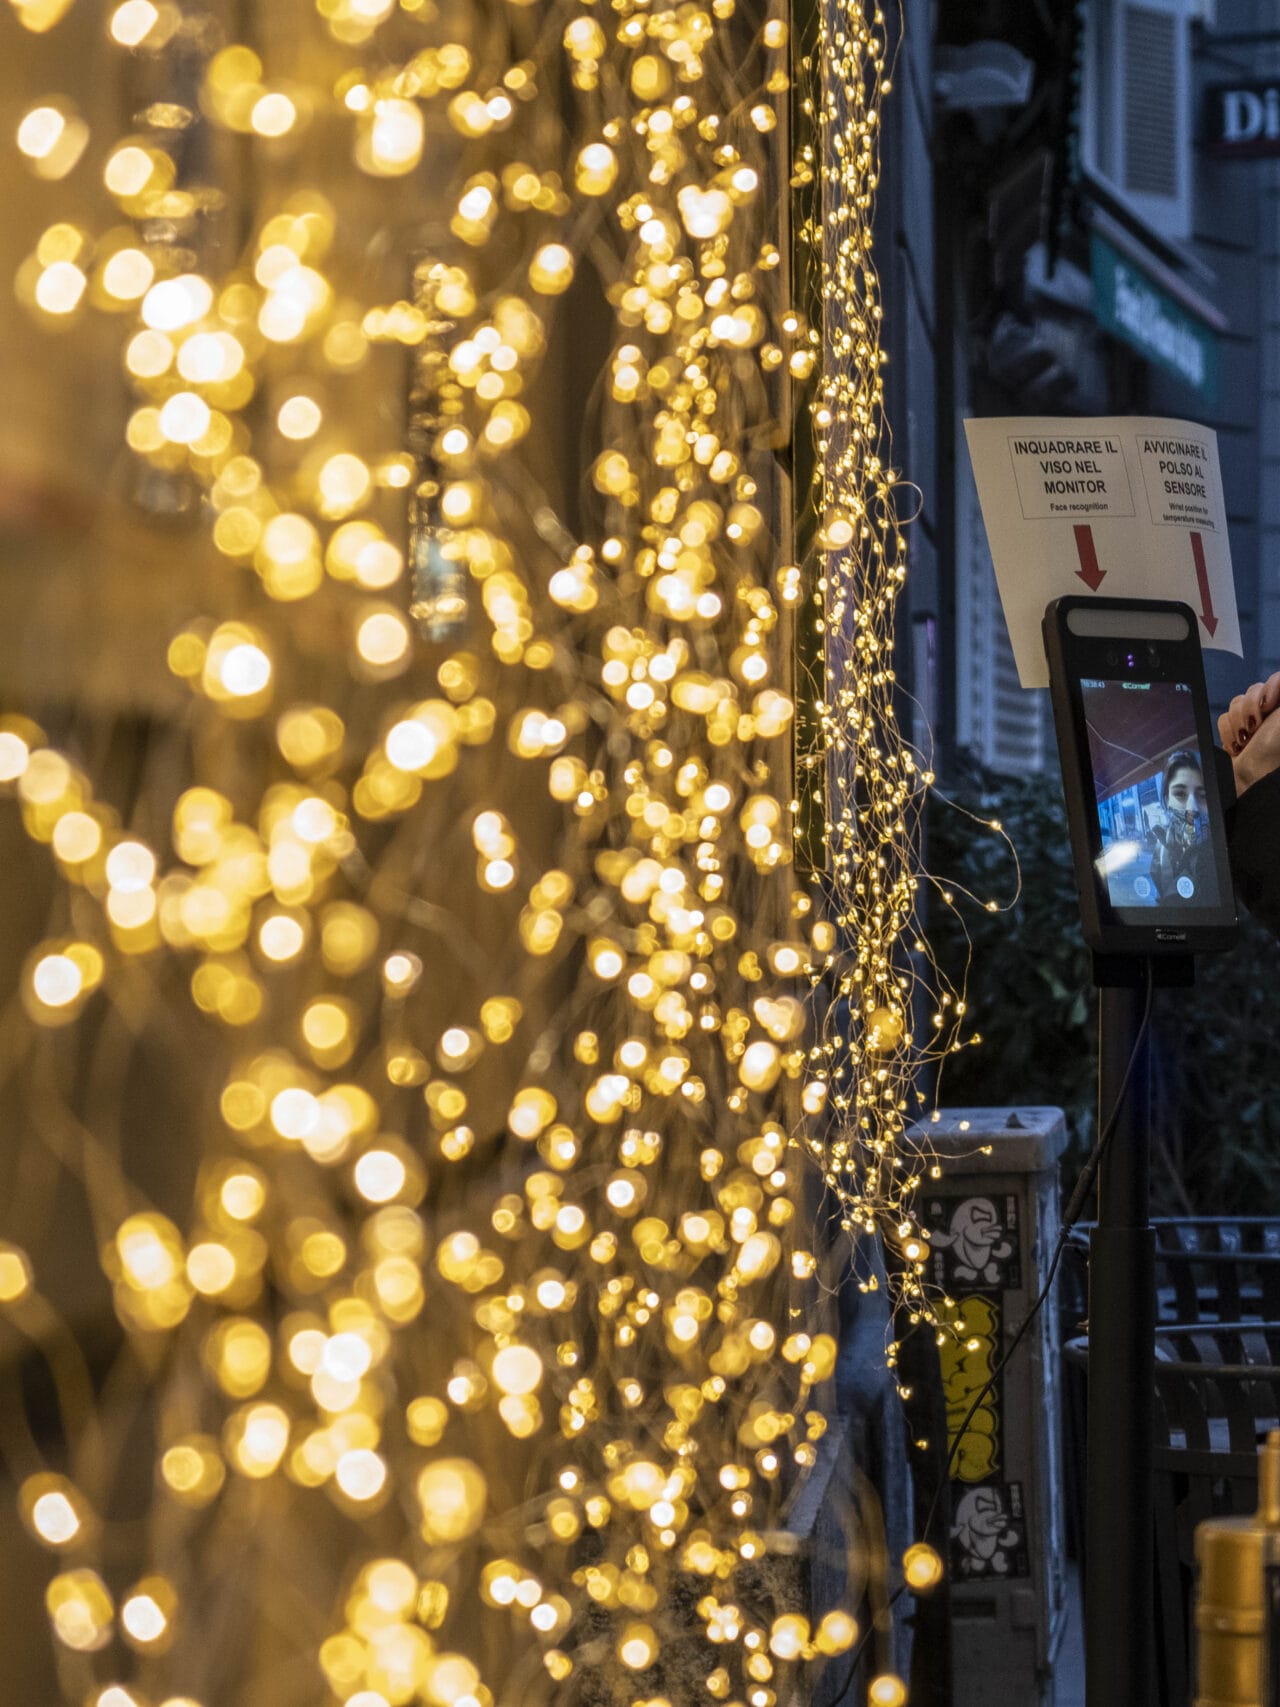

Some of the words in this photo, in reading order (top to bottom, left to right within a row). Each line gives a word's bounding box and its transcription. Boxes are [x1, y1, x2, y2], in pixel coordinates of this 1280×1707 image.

[1223, 88, 1280, 142] Di
[1014, 440, 1101, 454] INQUADRARE
[1104, 441, 1118, 454] IL
[1144, 440, 1200, 459] AVVICINARE
[1040, 460, 1072, 474] VISO
[1074, 460, 1102, 474] NEL
[1159, 461, 1193, 476] POLSO
[1195, 465, 1204, 479] AL
[1044, 480, 1107, 494] MONITOR
[1164, 481, 1206, 498] SENSORE
[1050, 502, 1068, 512] Face
[1069, 502, 1109, 513] recognition
